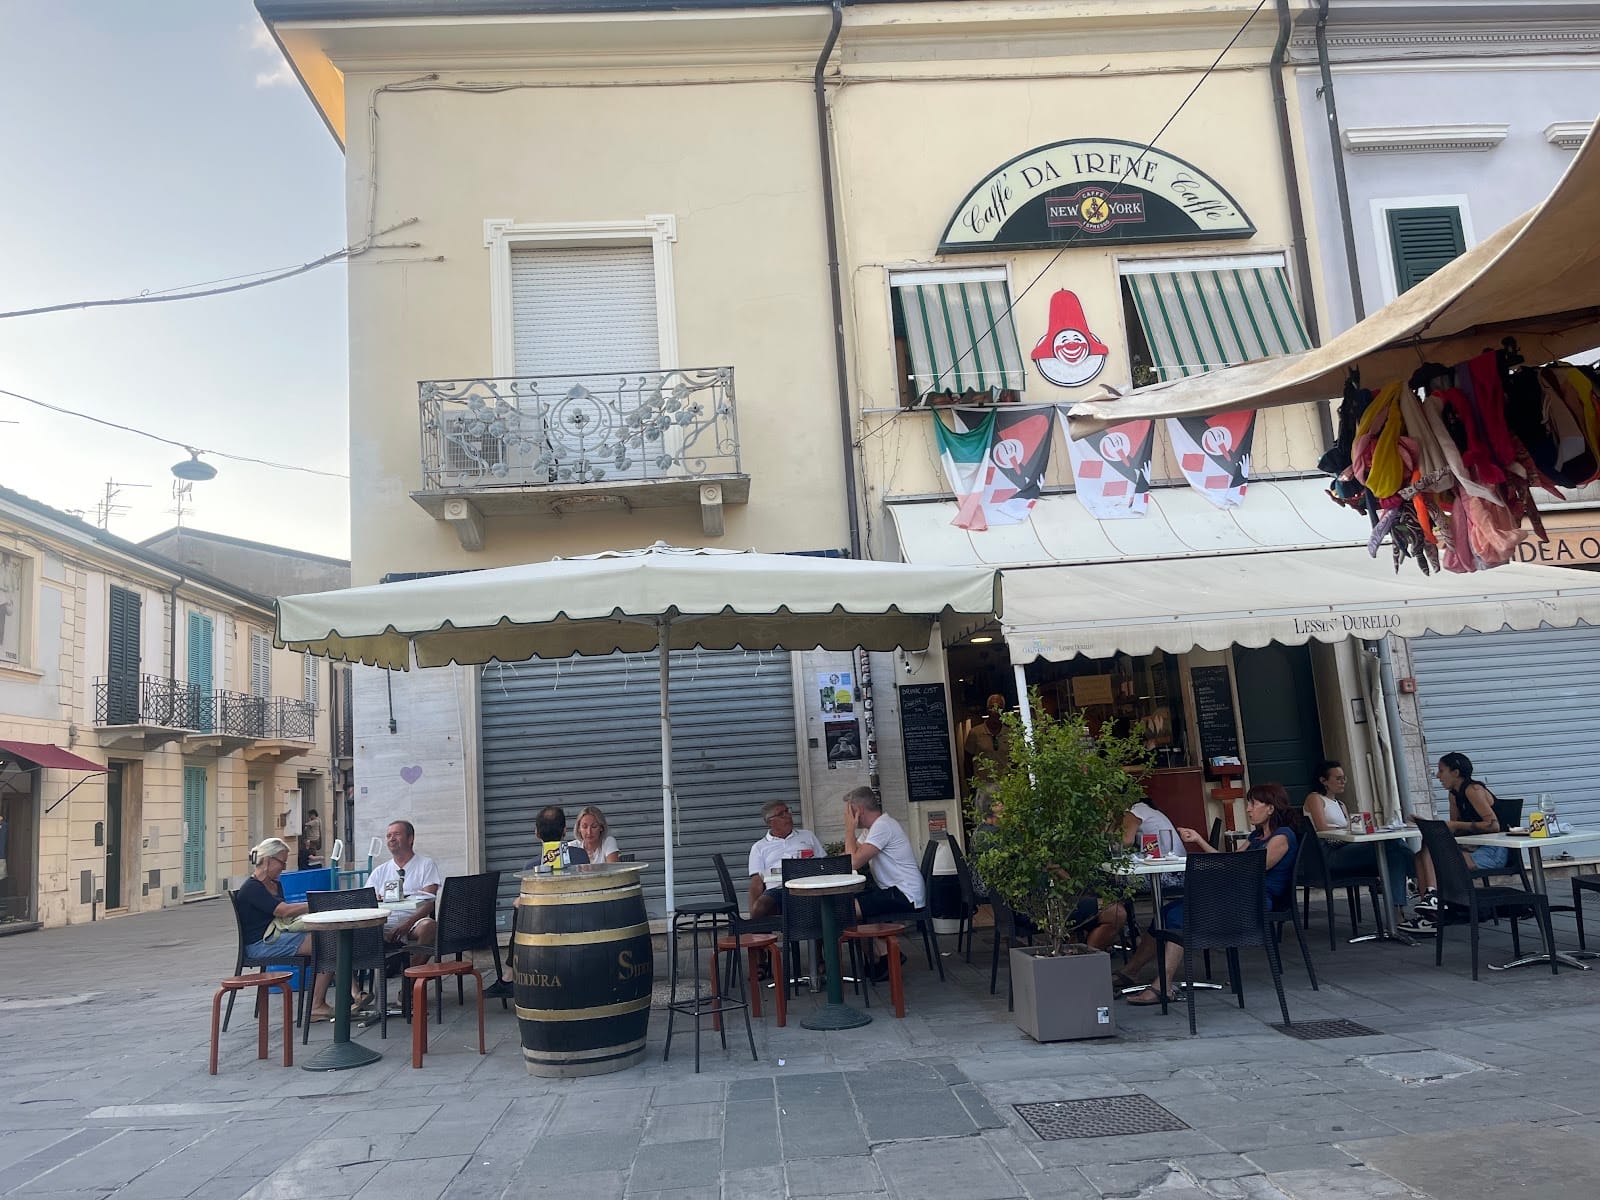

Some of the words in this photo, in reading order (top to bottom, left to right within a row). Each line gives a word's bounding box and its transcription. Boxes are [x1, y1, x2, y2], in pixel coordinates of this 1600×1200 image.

[1020, 159, 1062, 190] DA
[1073, 153, 1159, 184] IRENE
[1050, 204, 1079, 217] NEW
[1108, 202, 1142, 214] YORK
[1342, 614, 1401, 631] DURELLO
[923, 686, 939, 694] LIST
